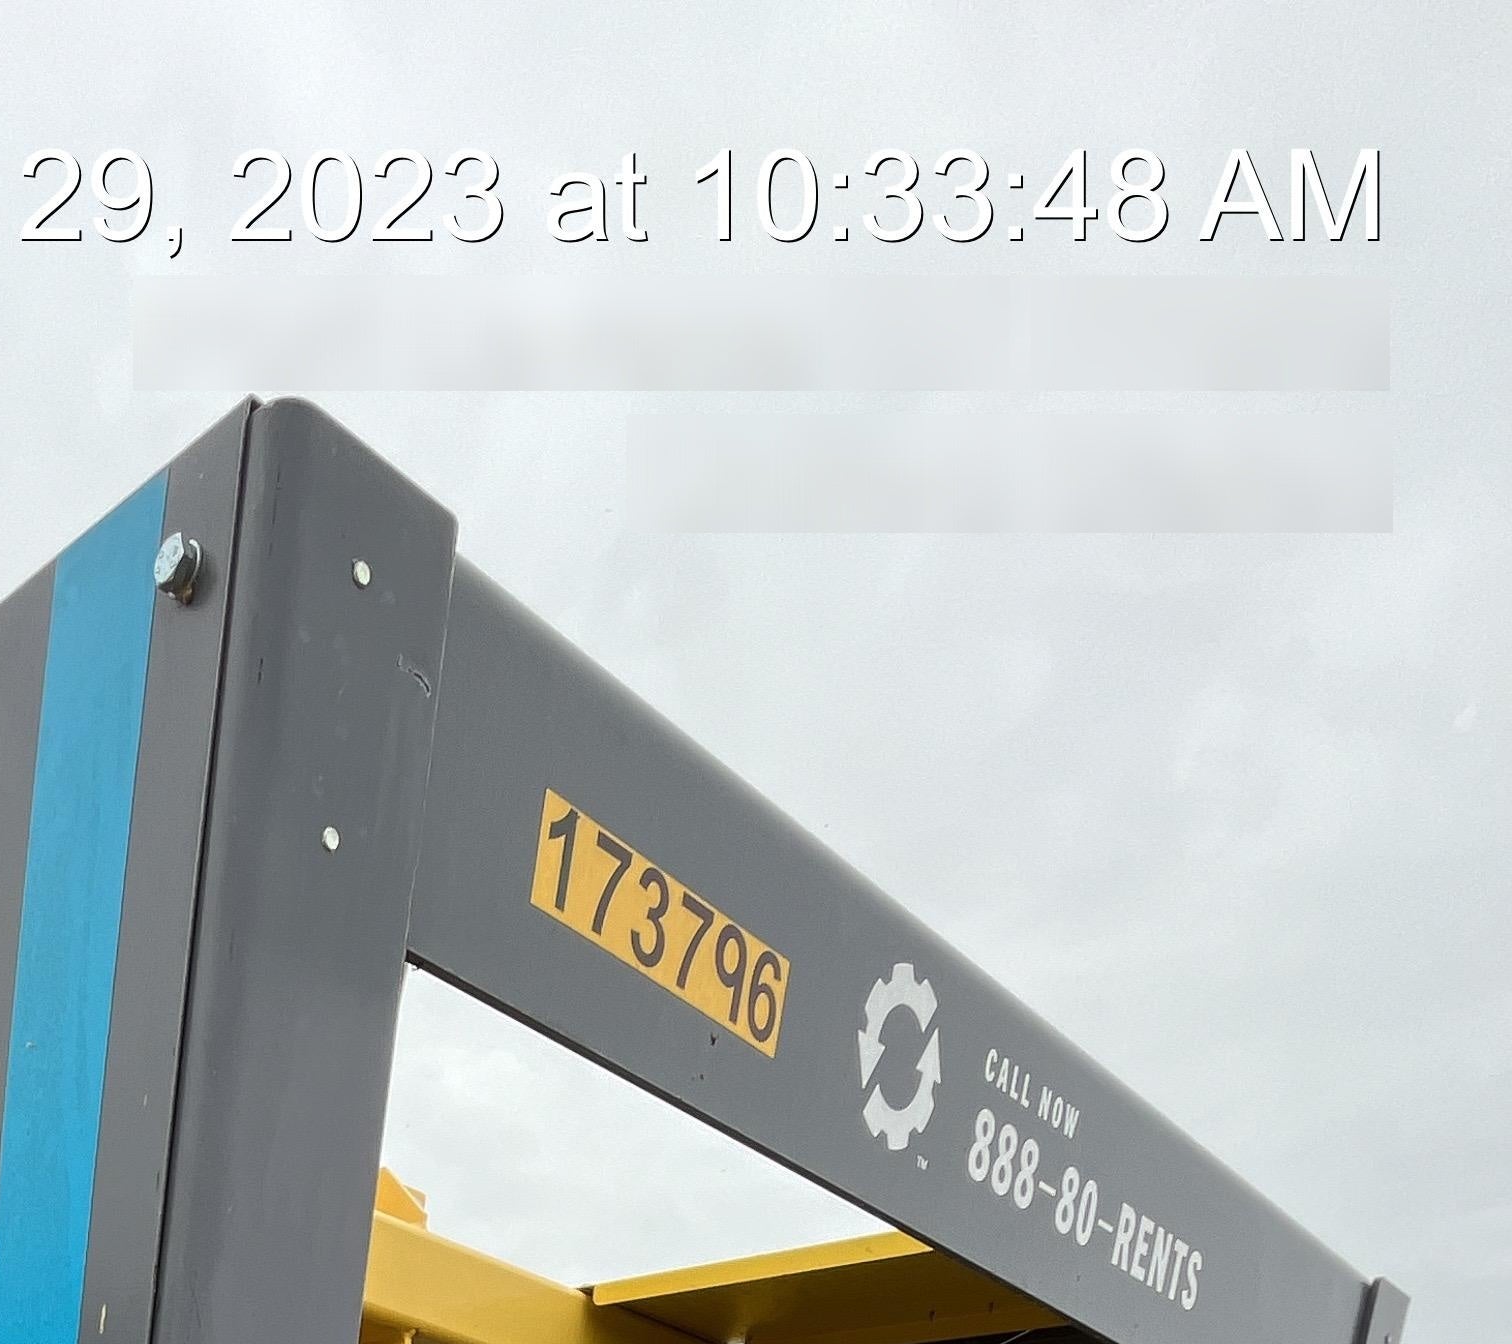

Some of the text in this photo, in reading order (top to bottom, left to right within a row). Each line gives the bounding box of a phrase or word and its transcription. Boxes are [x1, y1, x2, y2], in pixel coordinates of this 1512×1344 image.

[547, 806, 783, 1043] 173796
[984, 1048, 1080, 1140] CALL NOW
[967, 1108, 1203, 1311] 888-80-RENTS
